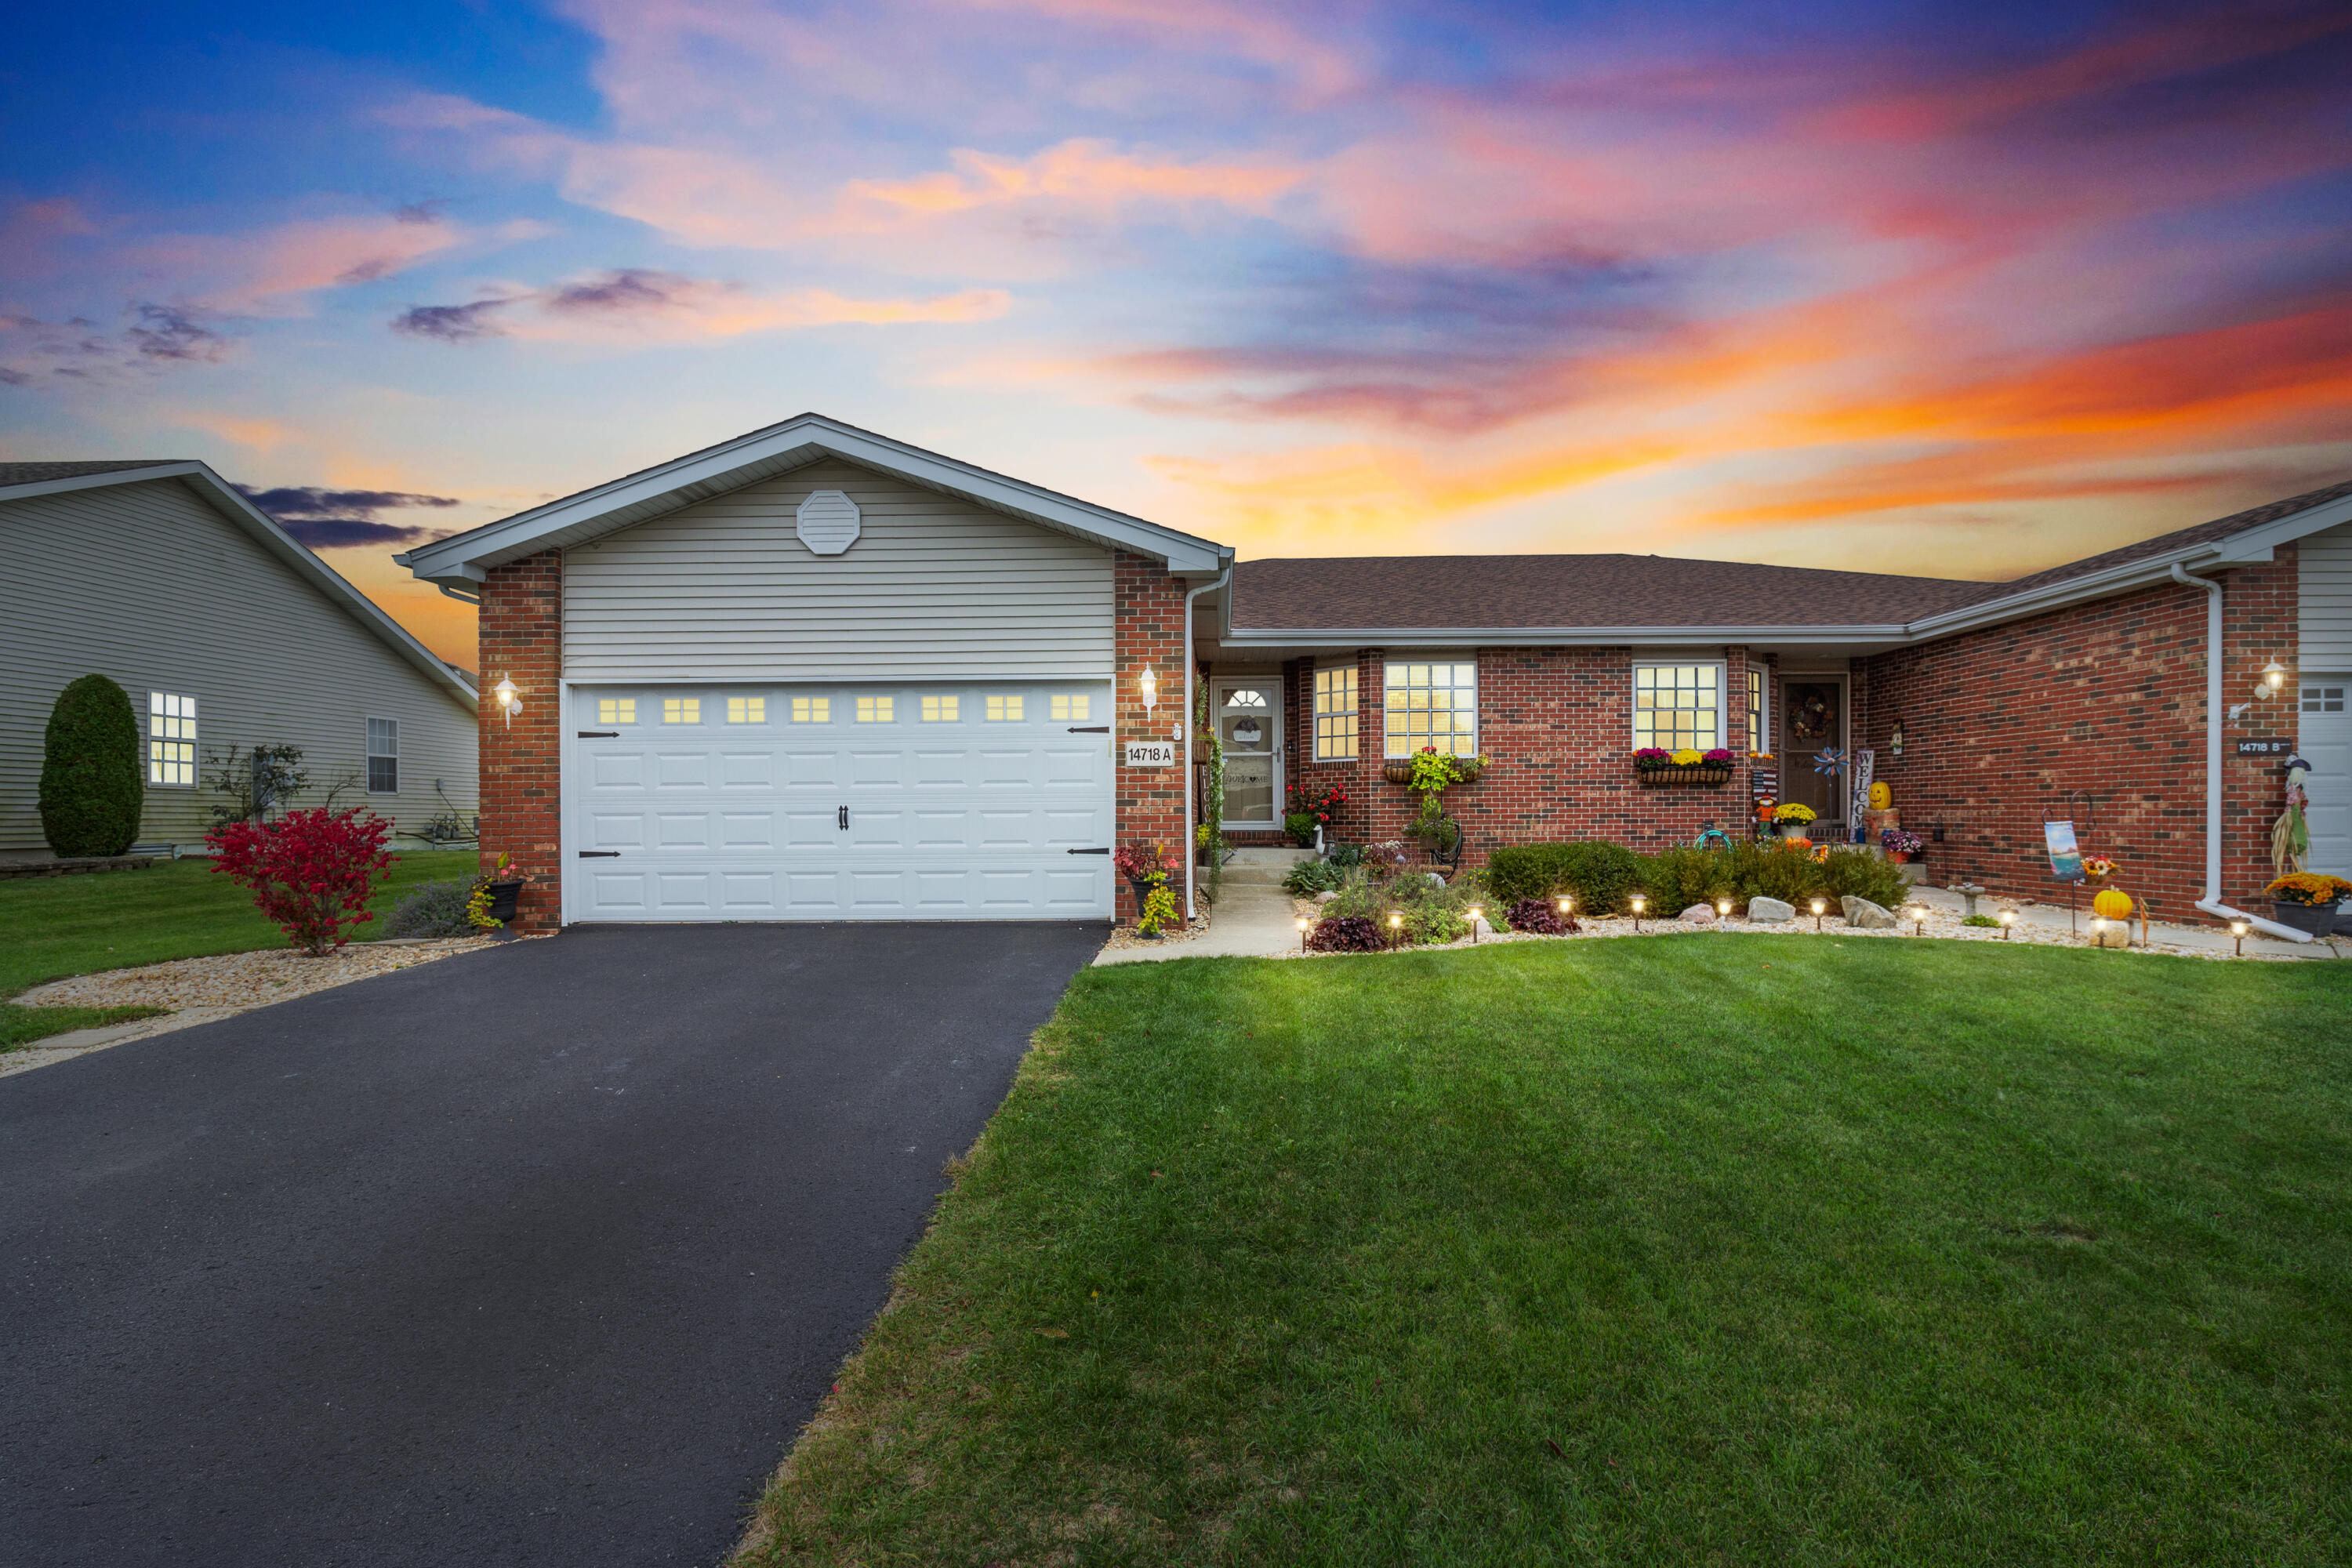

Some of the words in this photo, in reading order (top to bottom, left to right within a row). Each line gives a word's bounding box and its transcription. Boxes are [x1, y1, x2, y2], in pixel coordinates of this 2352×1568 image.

[2239, 742, 2268, 752] 14718
[2272, 742, 2280, 752] B
[1128, 748, 1160, 760] 14718
[1163, 748, 1171, 760] A
[1854, 753, 1872, 827] WELCOM
